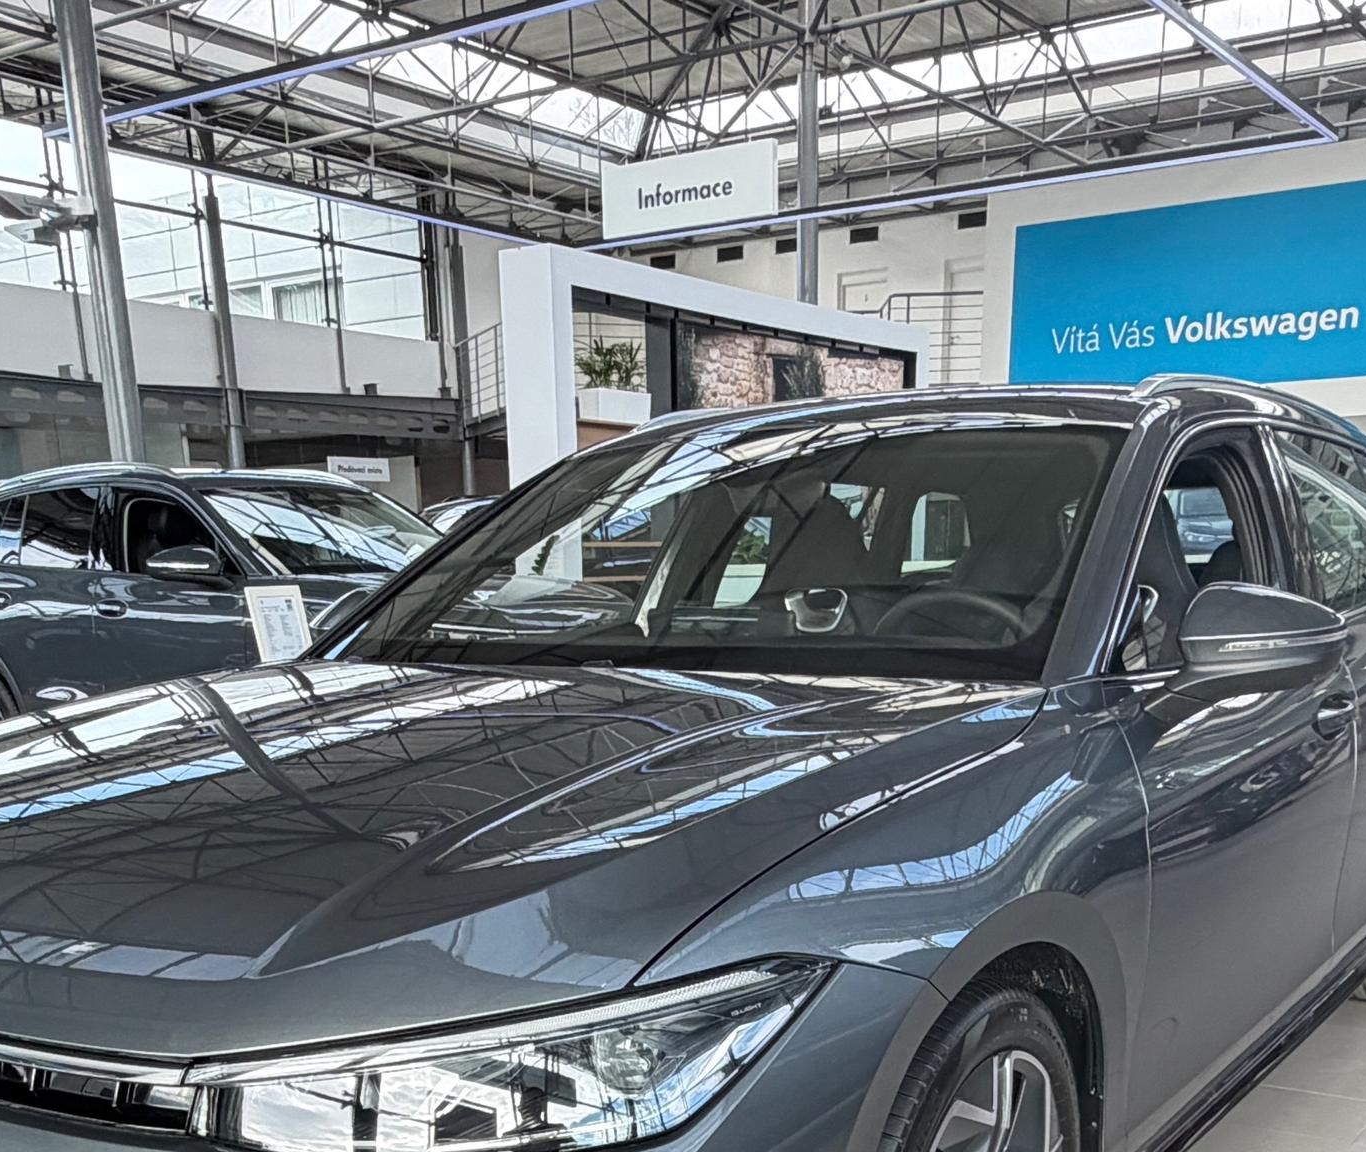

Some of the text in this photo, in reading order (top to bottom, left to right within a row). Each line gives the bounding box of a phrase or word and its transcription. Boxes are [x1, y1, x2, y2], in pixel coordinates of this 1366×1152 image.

[638, 180, 733, 210] Informace
[1051, 306, 1360, 355] Vítá Vás Volkswagen
